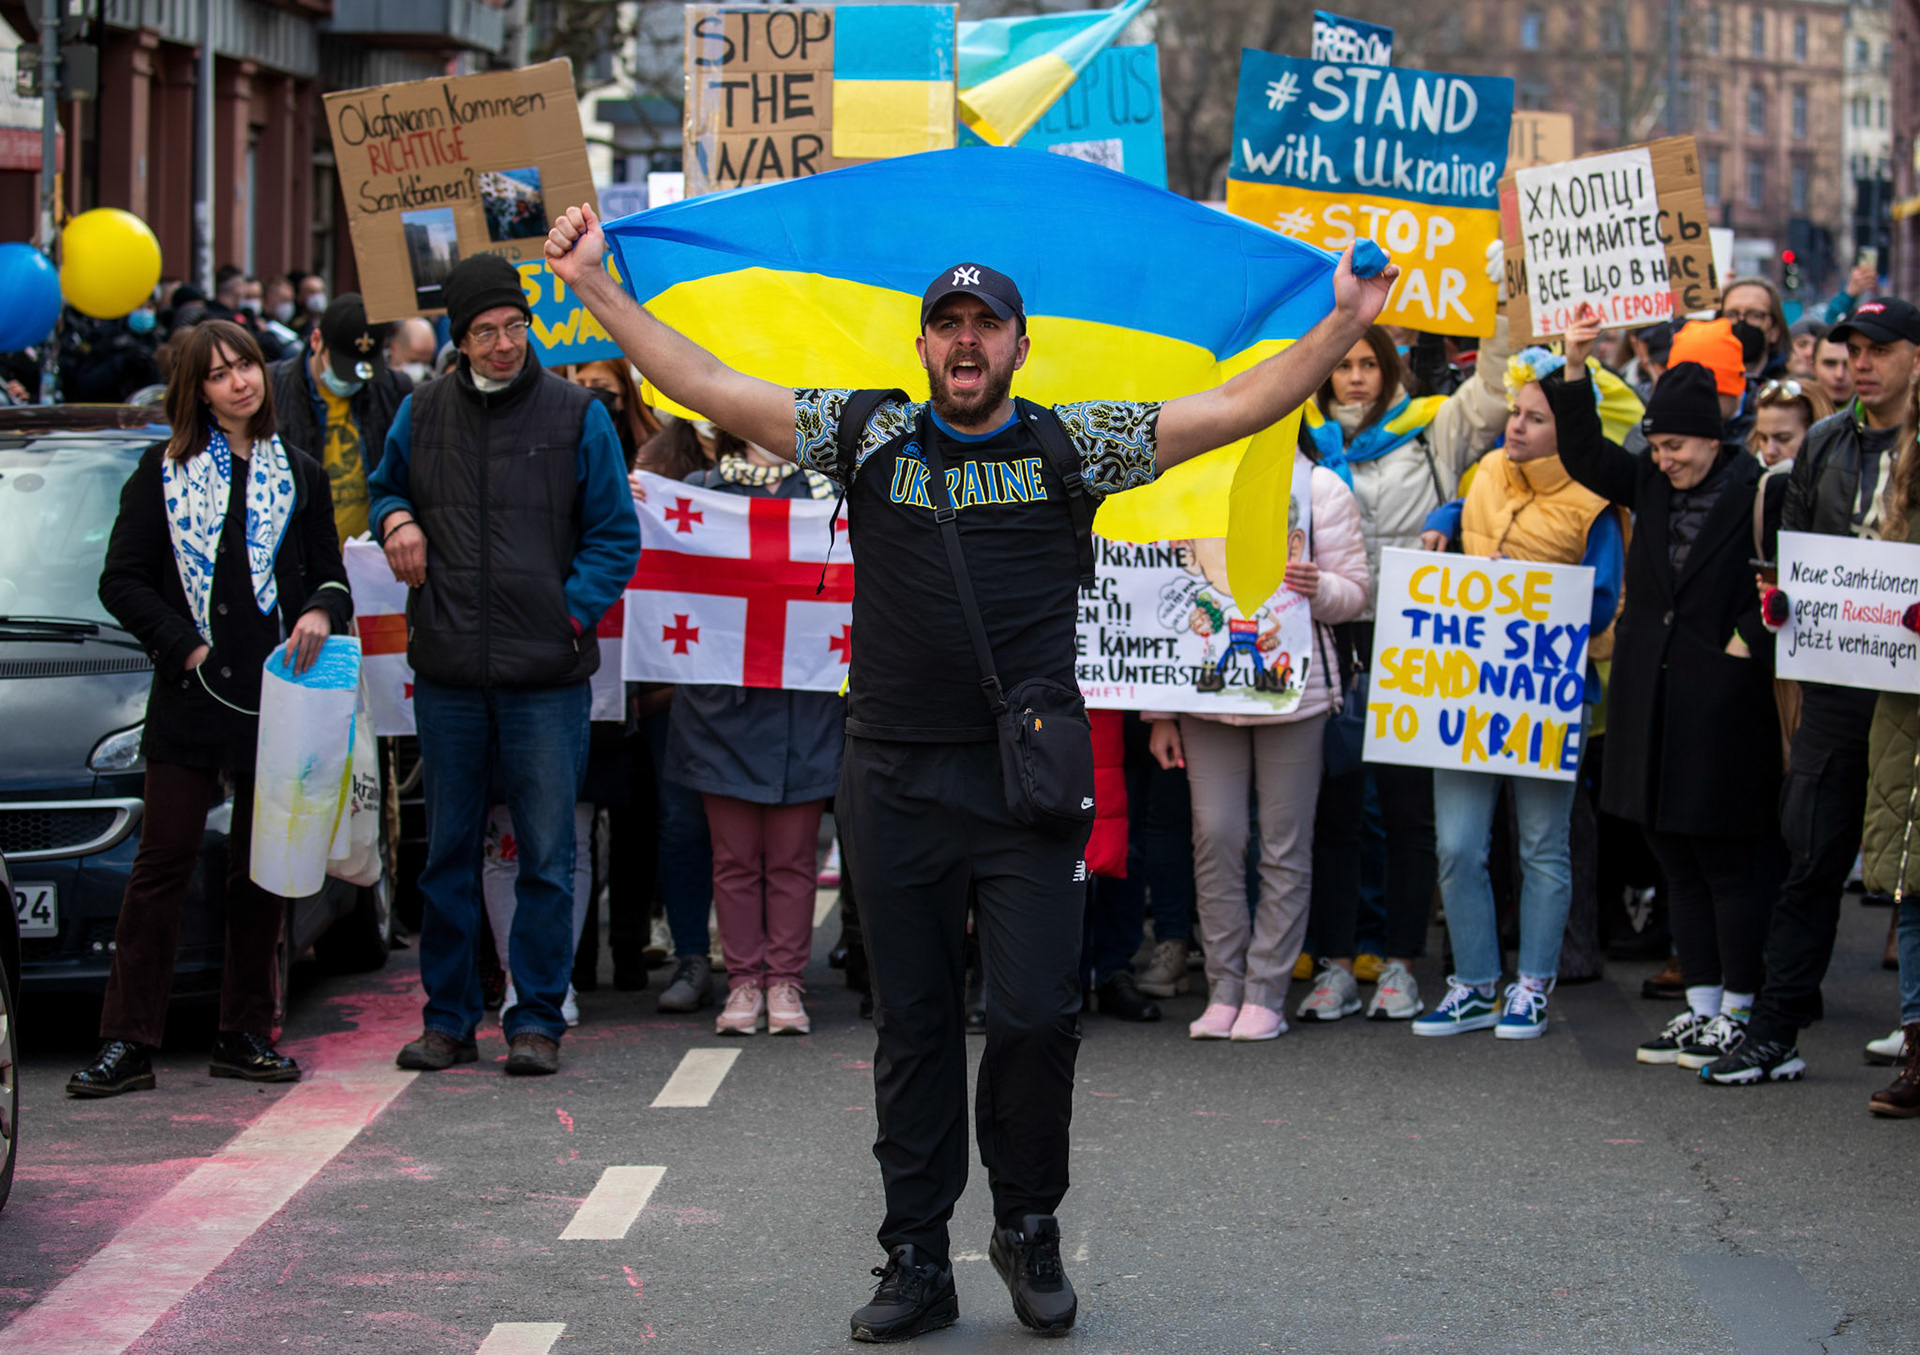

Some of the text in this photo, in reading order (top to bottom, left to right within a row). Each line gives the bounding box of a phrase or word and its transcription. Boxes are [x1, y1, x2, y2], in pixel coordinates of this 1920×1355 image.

[694, 8, 831, 66] STOP
[708, 73, 814, 128] THE
[1107, 49, 1156, 126] US
[367, 126, 469, 176] RICHTIGE
[694, 134, 824, 188] WAR
[1242, 134, 1341, 183] with
[1354, 136, 1497, 198] Ukraine
[1526, 167, 1644, 223] ХЛОПЦІ
[1528, 209, 1702, 264] ТРИМАЙТЕСЬ
[951, 266, 981, 287] NY
[1538, 268, 1571, 305] ВСЕ
[1583, 265, 1621, 296] ЩО
[1629, 258, 1645, 286] В
[1651, 254, 1700, 283] НАС
[530, 307, 614, 350] WA
[1611, 290, 1682, 321] ГЕРОЯМ
[890, 456, 1048, 510] UKRAINE
[1408, 565, 1553, 622] CLOSE
[1790, 561, 1919, 595] Neue Sanktionen
[1402, 609, 1591, 671] THE SKY
[1795, 600, 1838, 627] gegen
[1837, 634, 1917, 668] verhängen
[1479, 660, 1585, 712] NATO
[1368, 702, 1581, 772] TO UKRAINE
